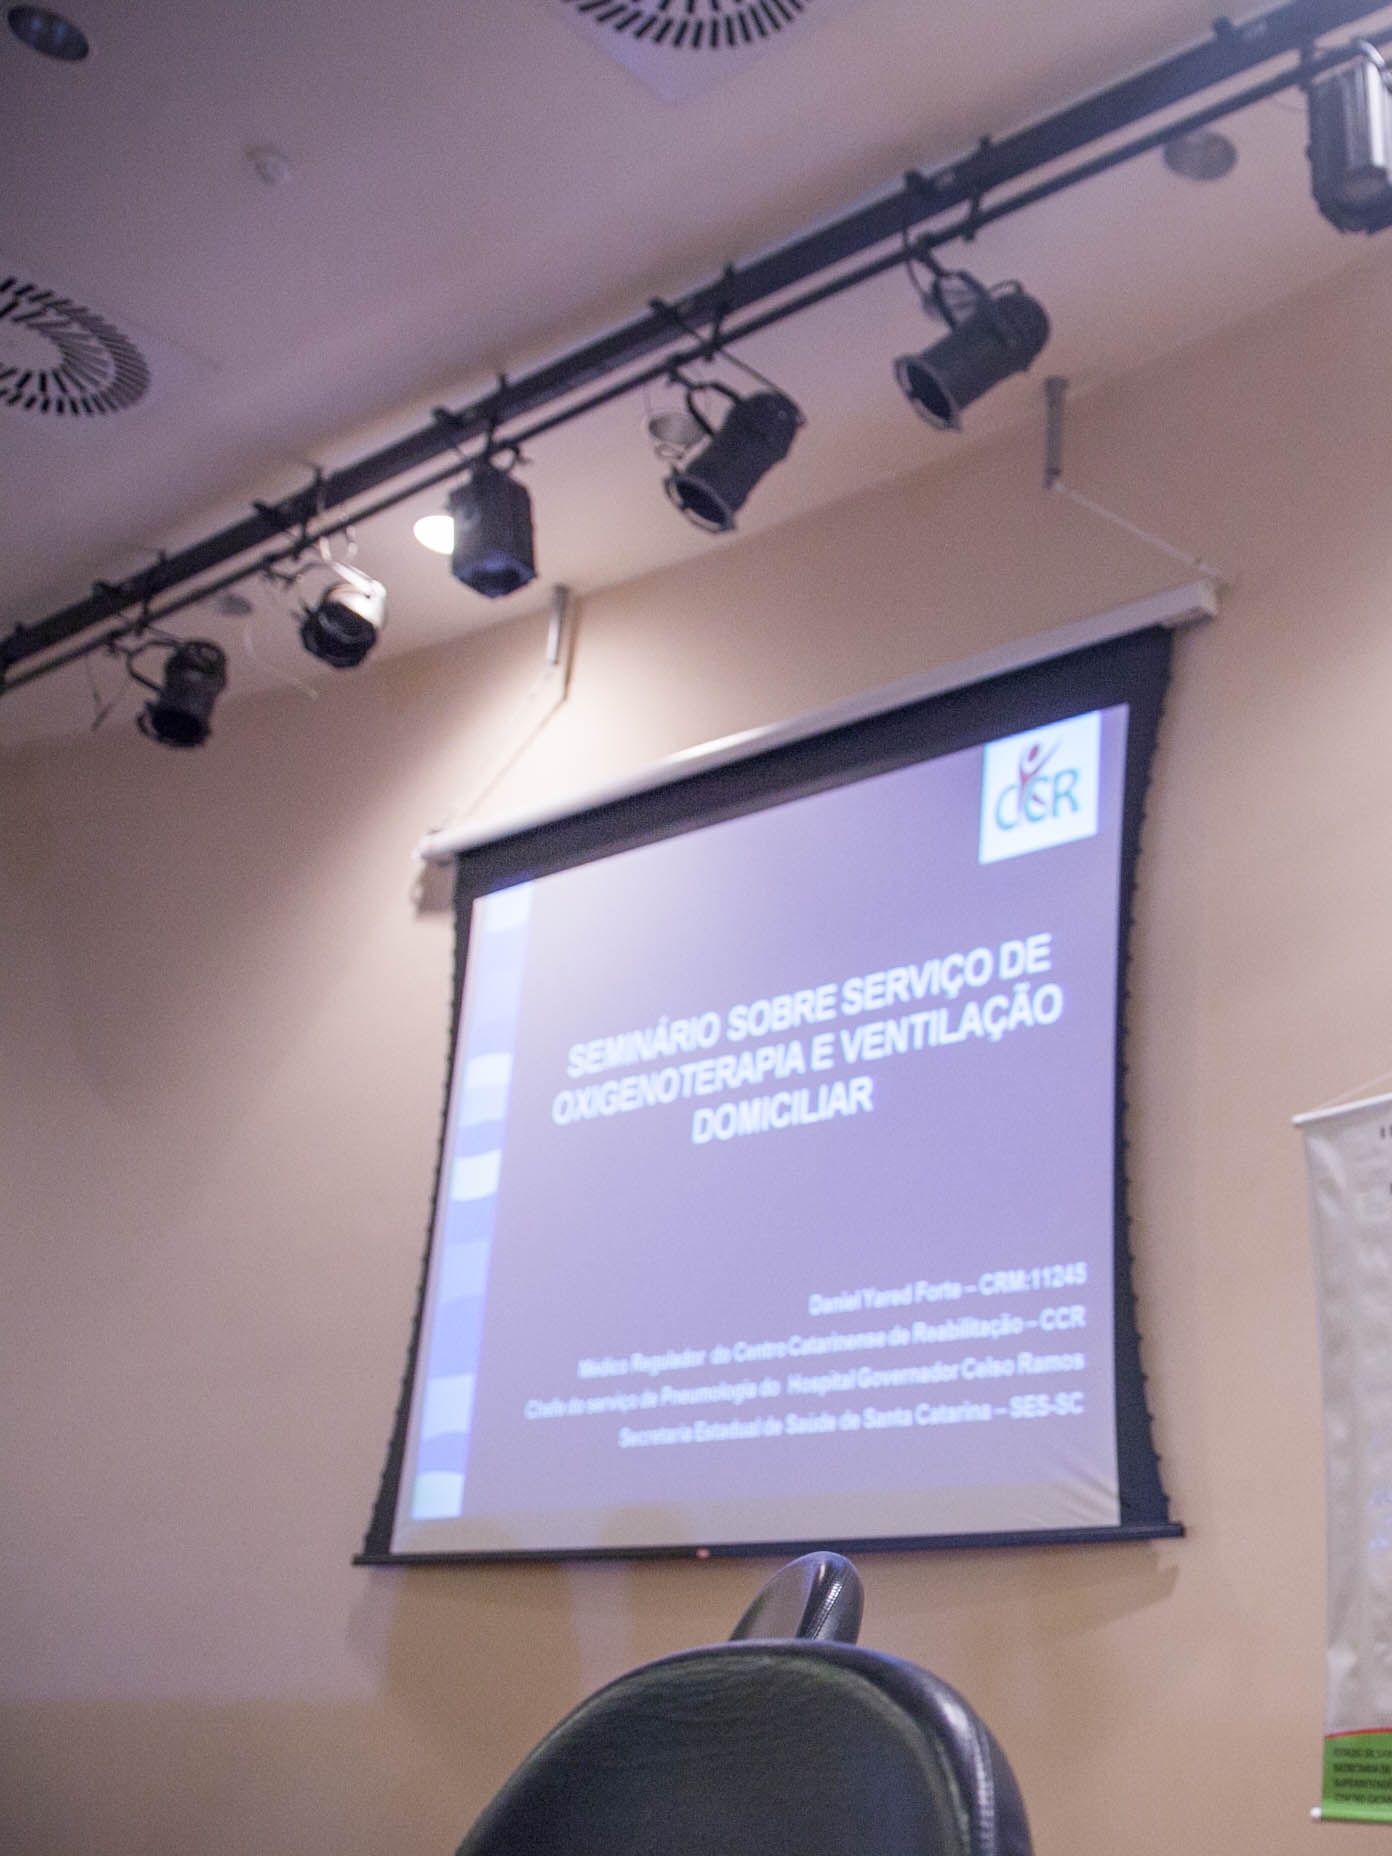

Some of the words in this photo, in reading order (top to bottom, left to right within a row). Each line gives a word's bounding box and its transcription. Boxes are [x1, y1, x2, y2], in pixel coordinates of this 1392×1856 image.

[995, 768, 1079, 831] CCR
[566, 1010, 722, 1079] SEMINÁRIO
[726, 982, 838, 1042] SOBRE
[840, 946, 994, 1016] SERVIÇO
[998, 931, 1053, 980] DE
[551, 1038, 807, 1127] OXIGENOTERAPIA
[809, 1031, 836, 1073] E
[839, 980, 1066, 1065] VENTILAÇÃO
[690, 1074, 875, 1145] DOMICILIAR
[1038, 1304, 1087, 1332] CCR
[1007, 1391, 1086, 1419] SES-SC
